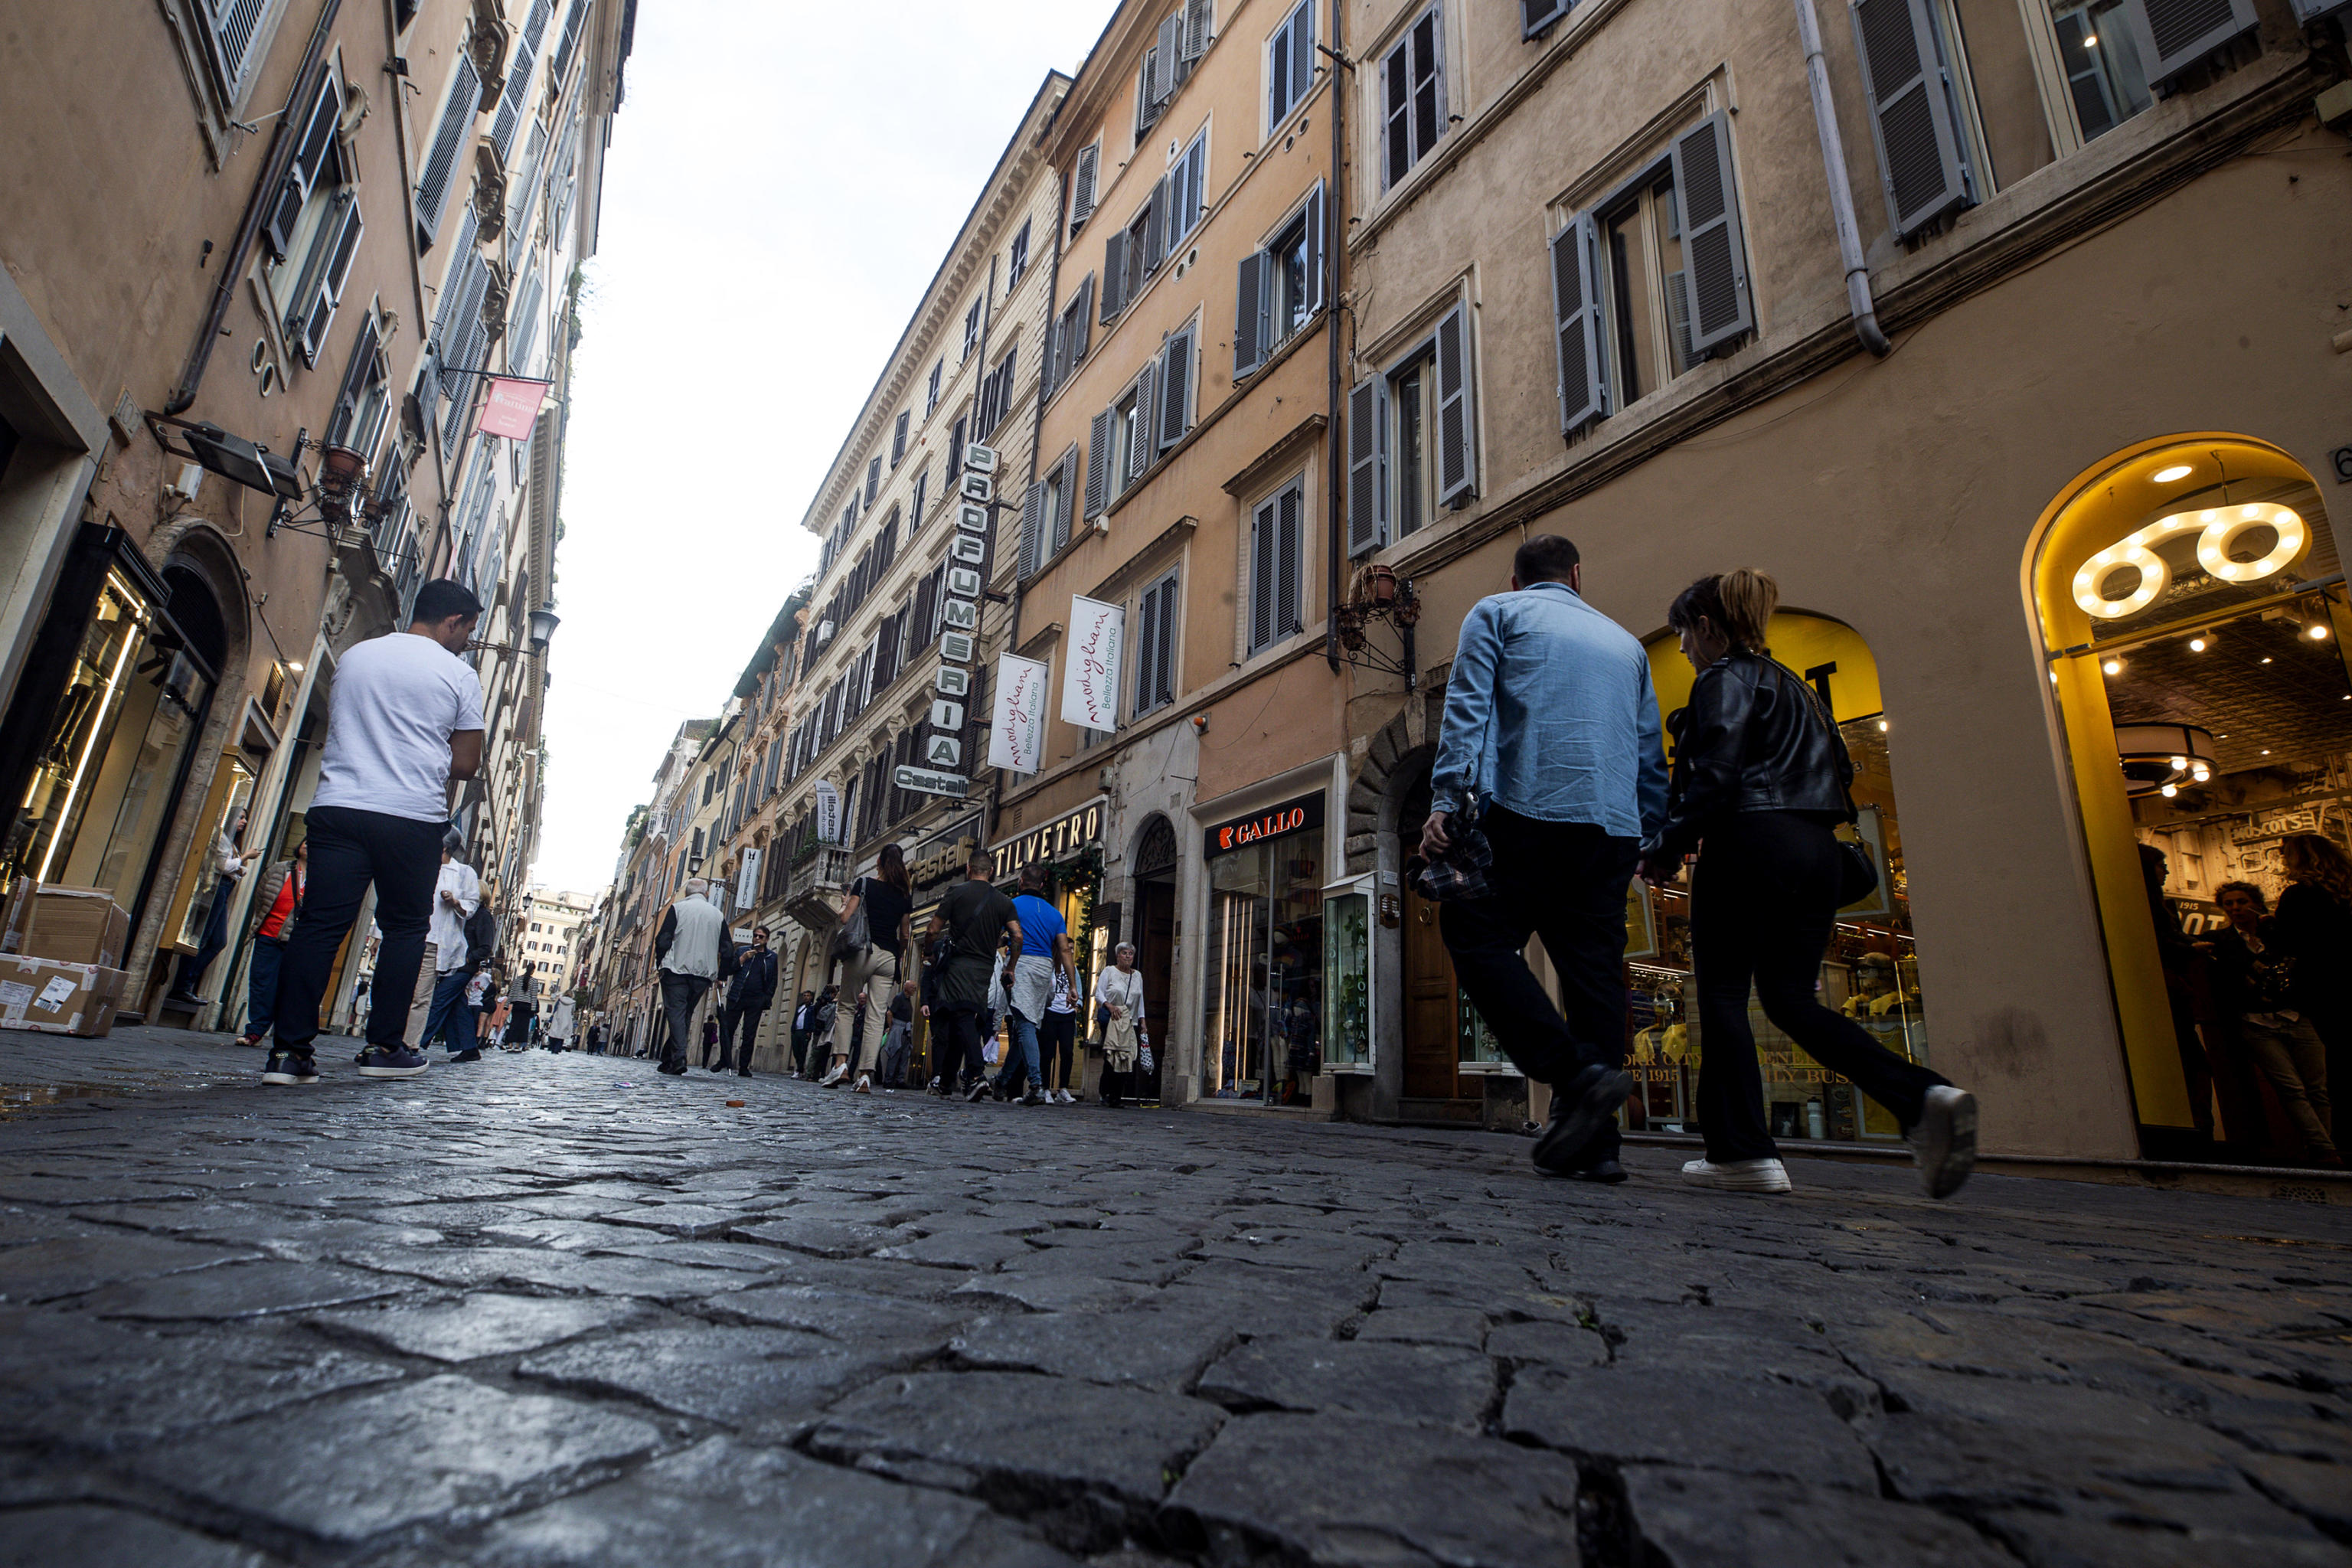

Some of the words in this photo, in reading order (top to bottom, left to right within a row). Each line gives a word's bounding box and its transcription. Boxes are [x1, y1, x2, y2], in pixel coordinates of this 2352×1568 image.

[930, 446, 991, 763] PROFUMERIA
[1107, 627, 1116, 666] Italiana
[1076, 612, 1109, 723] modigliani
[1027, 681, 1038, 717] Italiana
[1102, 668, 1113, 709] Bellezza
[1001, 667, 1033, 766] modigliani
[1024, 717, 1035, 755] Bellezza
[896, 769, 969, 794] Castelli
[988, 806, 1097, 877] TILVETRO
[1236, 808, 1305, 844] GALLO
[2180, 901, 2199, 910] 1915
[1357, 919, 1366, 1040] SARTORIA
[1648, 1069, 1680, 1082] 1915
